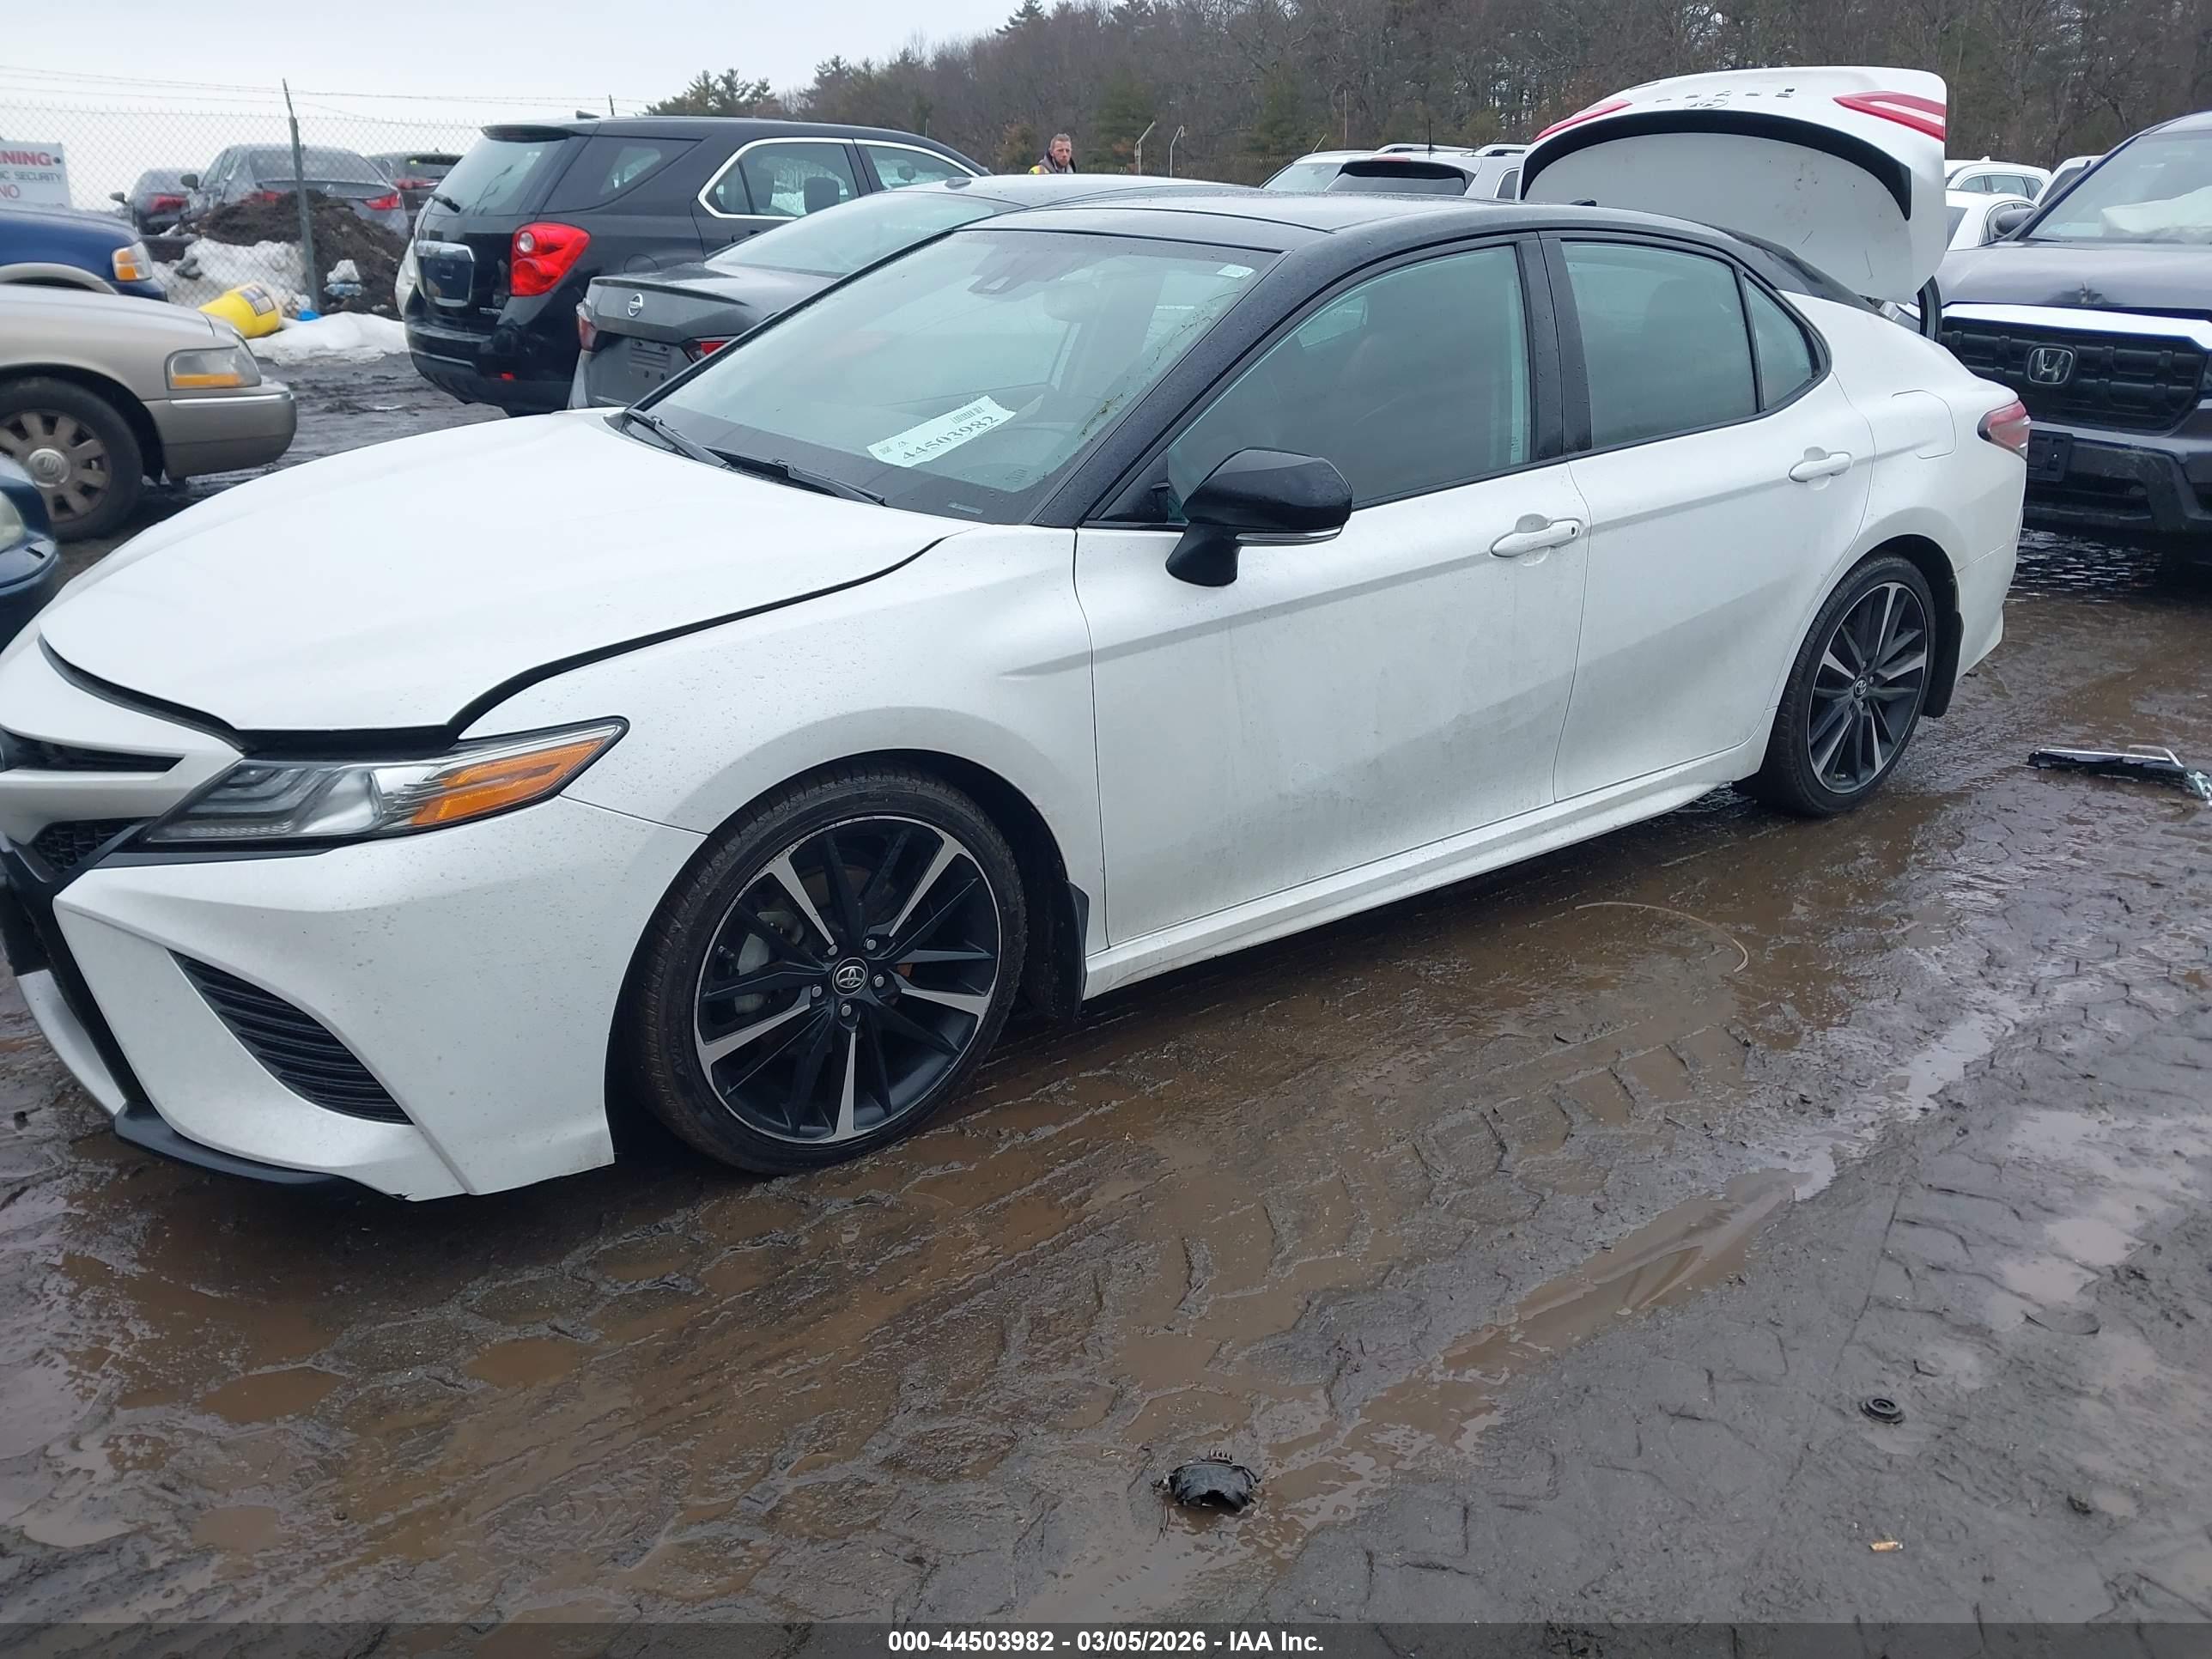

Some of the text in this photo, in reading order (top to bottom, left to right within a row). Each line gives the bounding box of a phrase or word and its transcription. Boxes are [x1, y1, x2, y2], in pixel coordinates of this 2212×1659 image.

[0, 150, 52, 166] NING
[13, 171, 62, 181] SECURITY
[902, 416, 1000, 459] 44503982
